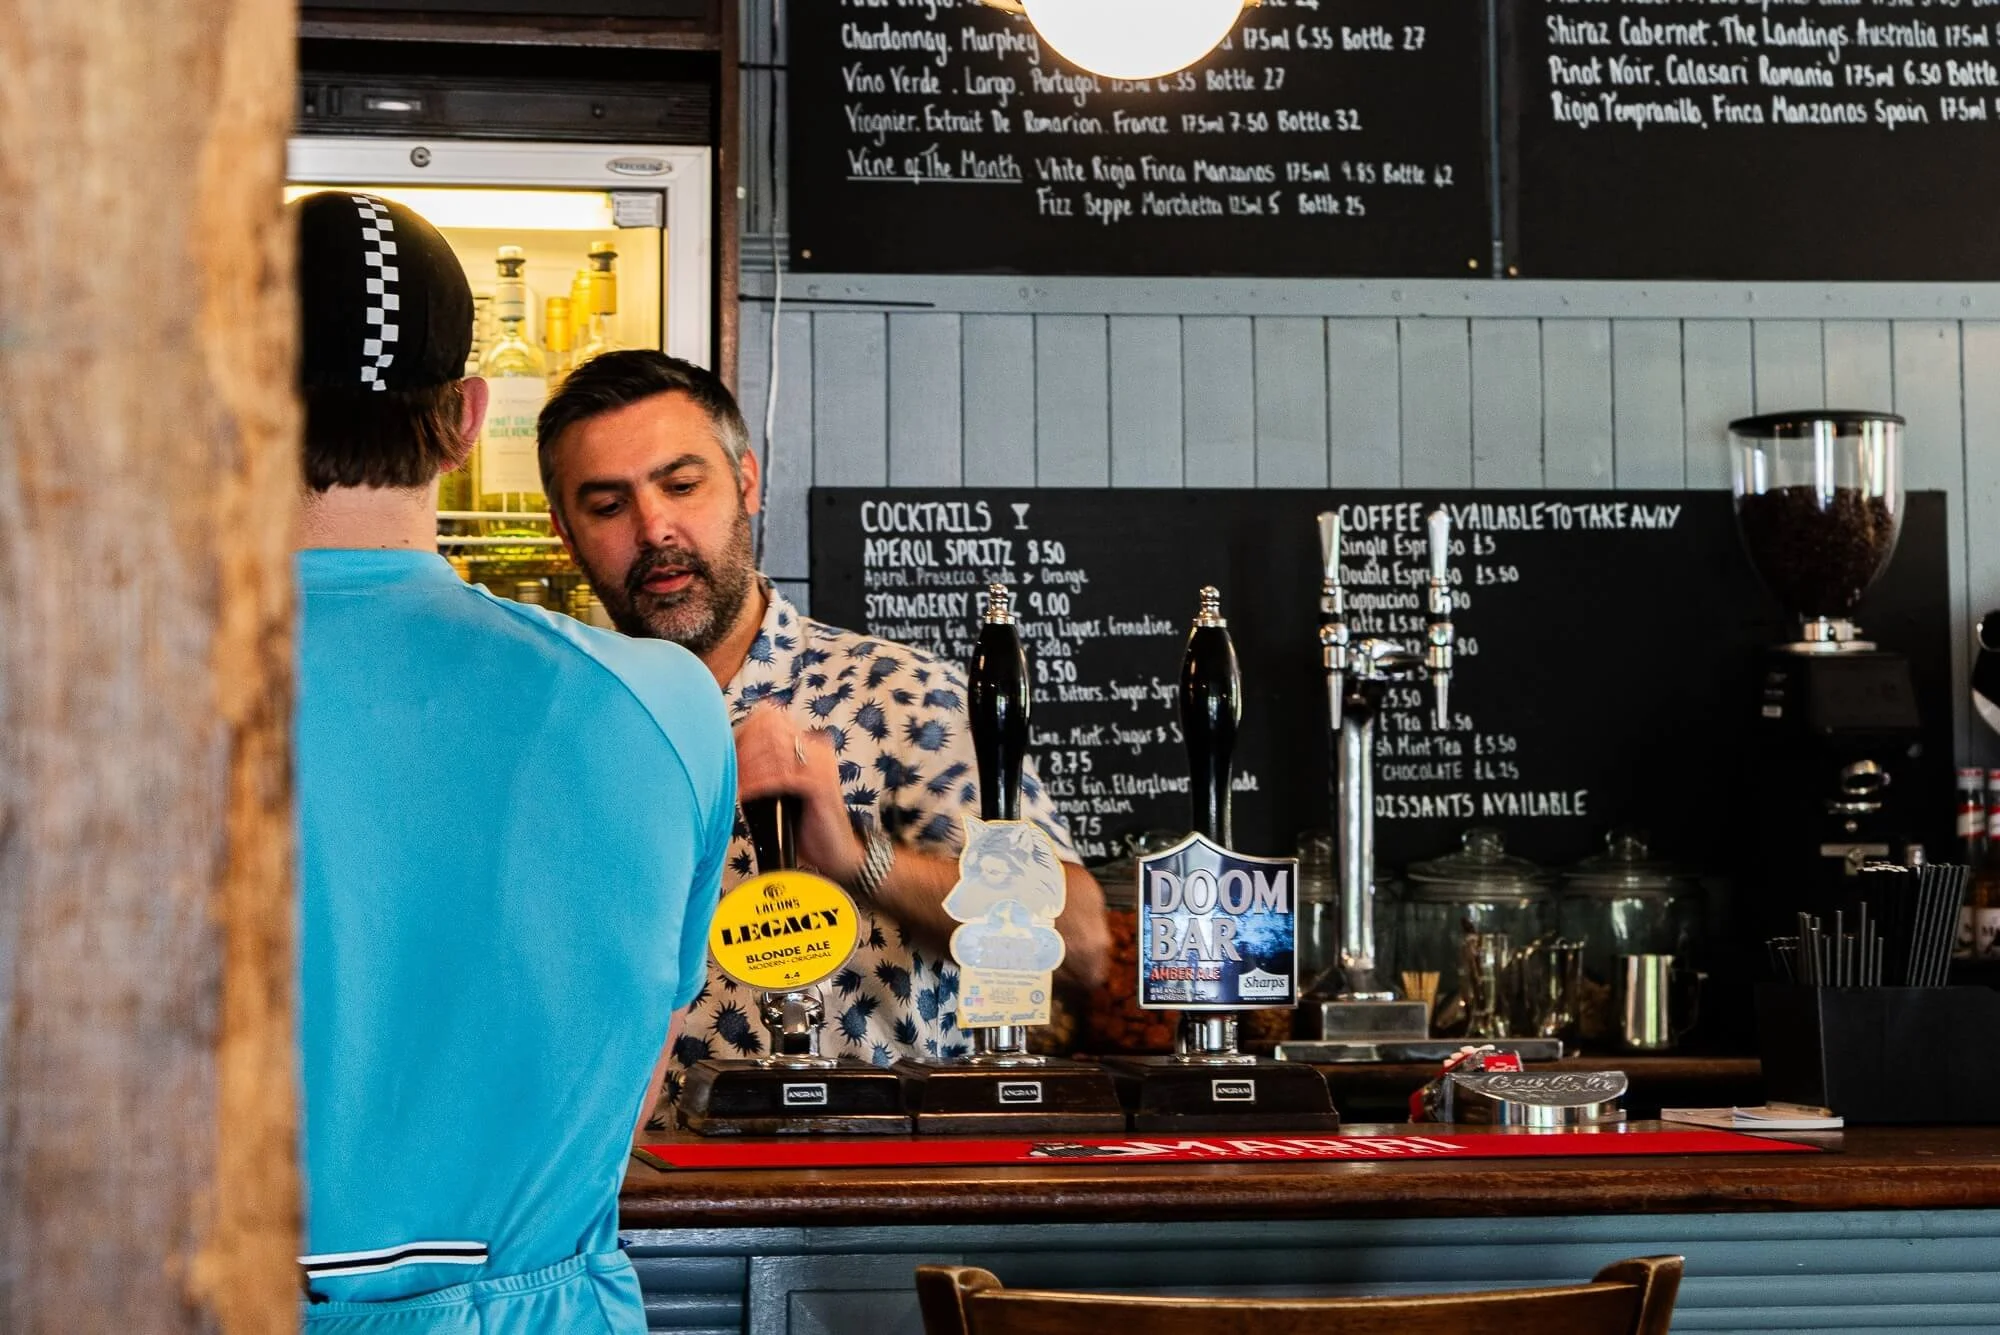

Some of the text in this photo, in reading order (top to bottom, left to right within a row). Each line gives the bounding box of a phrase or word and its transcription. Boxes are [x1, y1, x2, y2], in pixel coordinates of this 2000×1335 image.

[962, 27, 1040, 64] Murphey
[1243, 27, 1290, 49] 175ml
[1341, 26, 1394, 50] Bottle
[1403, 26, 1425, 49] 27
[1547, 15, 1611, 45] Shiraz
[1719, 15, 1758, 46] The
[1857, 18, 1938, 47] Australia
[1945, 25, 1989, 47] 175ml
[842, 62, 885, 94] Vino
[890, 65, 941, 95] Verde
[1029, 67, 1102, 106] Portugal
[1206, 68, 1254, 91] Bottle
[1264, 67, 1285, 91] 27
[1548, 55, 1602, 85] Pinot
[1666, 54, 1748, 85] Calasari
[1758, 55, 1833, 87] Romania
[1845, 65, 1894, 87] 175ml
[1946, 59, 1999, 86] Bottle
[924, 104, 983, 133] Extrait
[991, 109, 1010, 133] De
[1113, 110, 1168, 134] France
[1182, 114, 1224, 133] 175ml
[1229, 111, 1269, 132] 7.50
[1277, 109, 1332, 132] Bottle
[1335, 108, 1362, 131] 32
[1551, 91, 1599, 129] Rioja
[1712, 94, 1764, 124] Finca
[1772, 95, 1867, 124] Manzanos
[1874, 97, 1929, 130] Spain
[1940, 97, 1987, 121] 175ml
[848, 147, 897, 176] Wine
[920, 143, 953, 178] The
[961, 149, 1022, 178] Month
[1035, 155, 1087, 181] White
[1091, 155, 1136, 189] Rioja
[1140, 156, 1187, 183] Finca
[1194, 160, 1276, 183] Manzanos
[1286, 161, 1330, 182] 175ml
[1383, 162, 1426, 185] Bottle
[1036, 185, 1074, 216] Fizz
[1268, 190, 1281, 215] 5
[1298, 193, 1341, 215] Bottle
[1346, 195, 1366, 216] 25
[861, 500, 993, 533] COCKTAILS
[1338, 503, 1422, 532] COFFEE
[1631, 505, 1681, 529] AWAY
[864, 537, 1066, 567] APEROL SPRITZ 8.50
[1340, 535, 1388, 562] Single
[1393, 533, 1465, 563] Esprso
[983, 567, 1018, 585] Soda
[1340, 563, 1389, 586] Double
[865, 592, 968, 619] STRAWBERRY
[1029, 592, 1071, 616] 9.00
[867, 621, 941, 648] Strawberry
[1036, 641, 1072, 656] Soda
[1036, 660, 1078, 684] 8.50
[1110, 680, 1149, 711] Sugar
[1392, 712, 1422, 732] Tea
[1111, 722, 1153, 755] Sugar
[1397, 734, 1431, 756] Mint
[1433, 736, 1462, 756] Tea
[1050, 751, 1092, 774] 8.75
[1382, 761, 1463, 780] CHOCOLATE
[1091, 797, 1134, 814] Balm
[1376, 789, 1588, 818] OISSANTS AVAILABLE
[1150, 869, 1289, 915] DOOM
[721, 908, 839, 946] LEGACY
[1150, 917, 1243, 962] BAR
[746, 940, 831, 964] BLONDE ALE
[783, 971, 801, 980] 4.4
[1150, 966, 1221, 981] AMBER ALE
[1243, 976, 1286, 993] Sharp's
